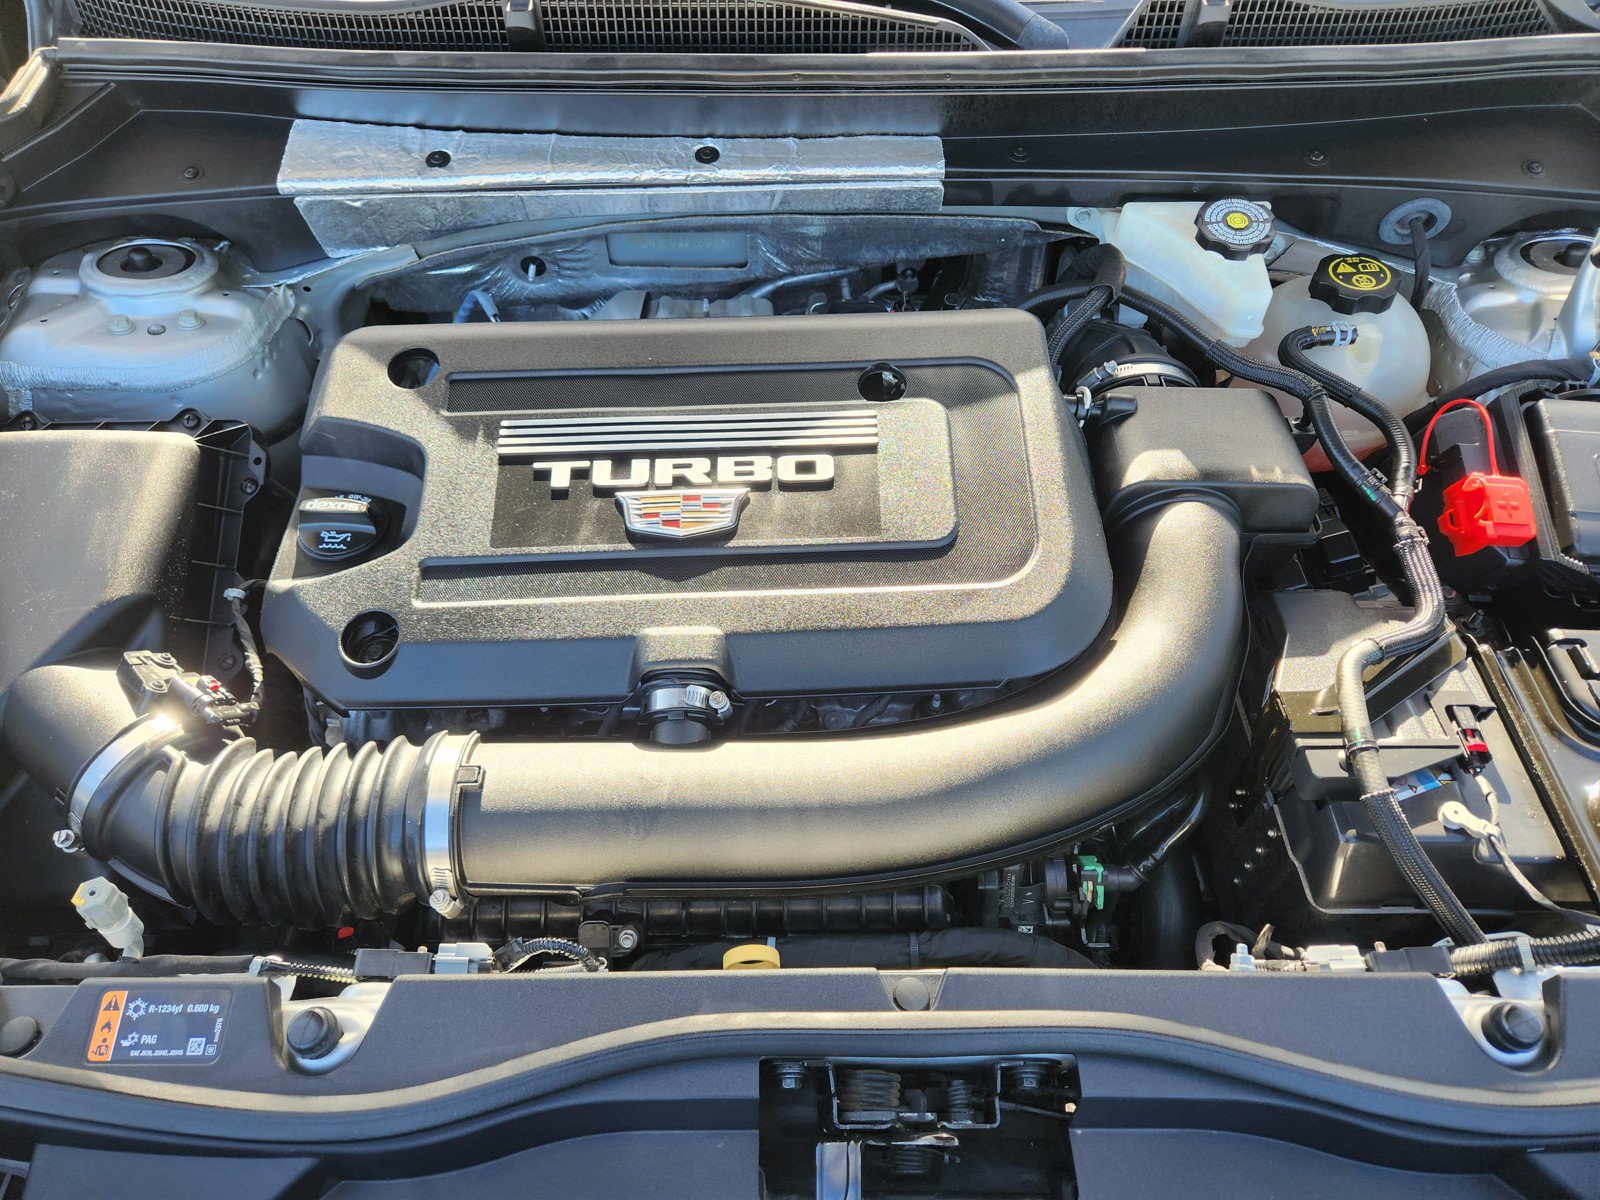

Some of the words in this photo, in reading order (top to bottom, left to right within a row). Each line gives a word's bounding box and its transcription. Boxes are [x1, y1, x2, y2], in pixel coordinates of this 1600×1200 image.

[533, 454, 834, 489] TURBO
[148, 1004, 183, 1014] R-1234yf
[187, 1004, 208, 1013] 0.600
[209, 1003, 220, 1014] kg
[140, 1034, 158, 1045] PAG
